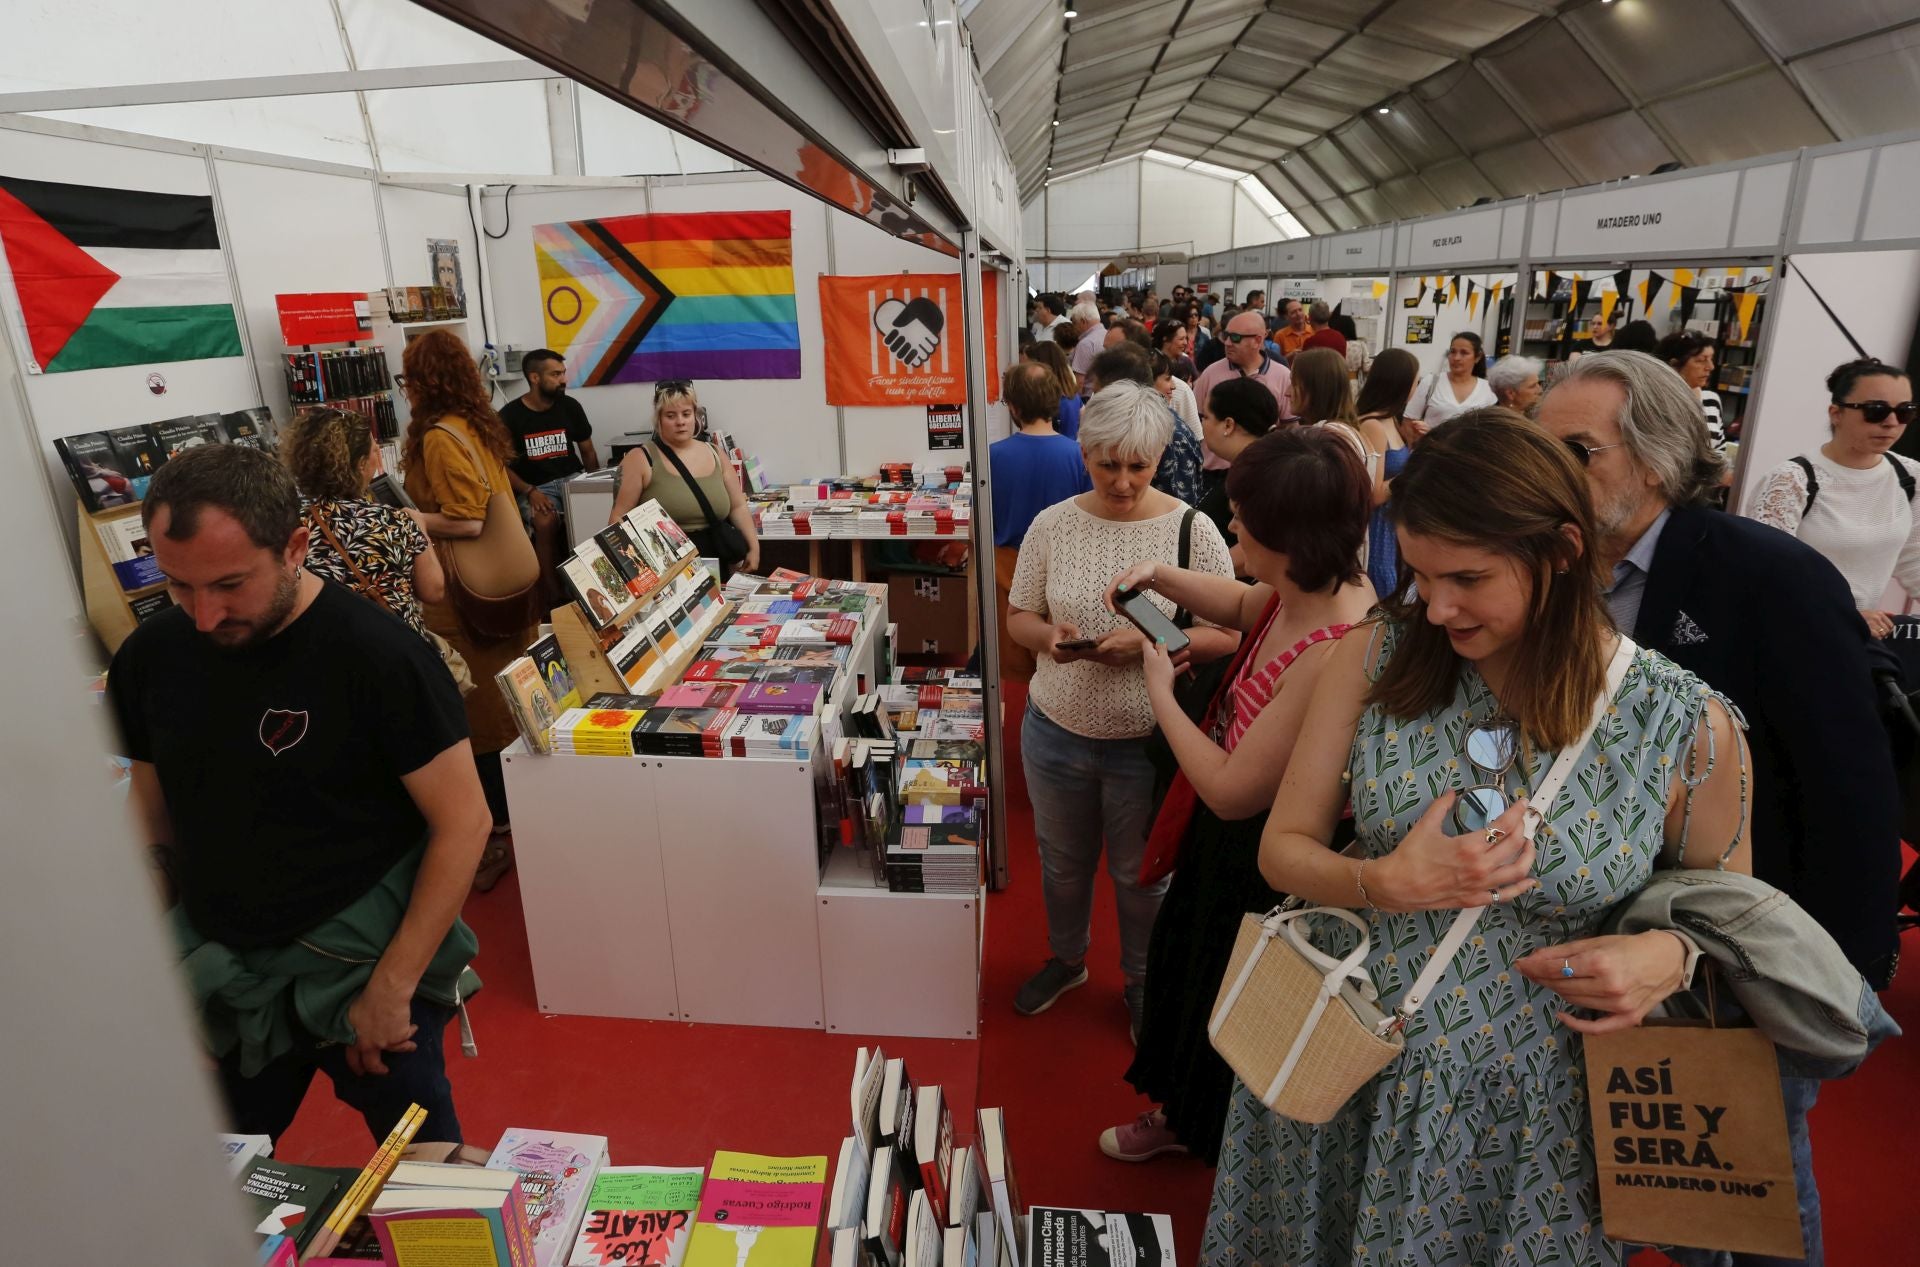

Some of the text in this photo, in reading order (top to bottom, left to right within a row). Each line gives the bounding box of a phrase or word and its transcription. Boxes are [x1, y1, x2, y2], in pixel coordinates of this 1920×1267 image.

[1597, 212, 1662, 229] MATADERO UNO
[1432, 236, 1462, 248] PEZ DE PLATA
[868, 375, 896, 388] Facer
[928, 413, 961, 423] LLIBERTÁ
[525, 431, 568, 449] LLIBERTÁ
[527, 444, 568, 457] 6DELASUIZA
[1606, 1057, 1673, 1095] ASÍ
[1609, 1101, 1728, 1134] FUE Y
[1613, 1132, 1734, 1171] SERÁ.
[247, 1179, 286, 1194] PALESTINA
[250, 1173, 291, 1188] MARXISMO
[1615, 1173, 1769, 1198] MATADERO UNO
[722, 1199, 812, 1212] Rodrigo Cuevas
[585, 1210, 689, 1242] CÁLLATE
[1042, 1211, 1052, 1237] Clara
[1070, 1215, 1080, 1244] queman
[1072, 1244, 1078, 1255] se
[1079, 1224, 1087, 1259] hombres
[1137, 1246, 1146, 1258] AdN
